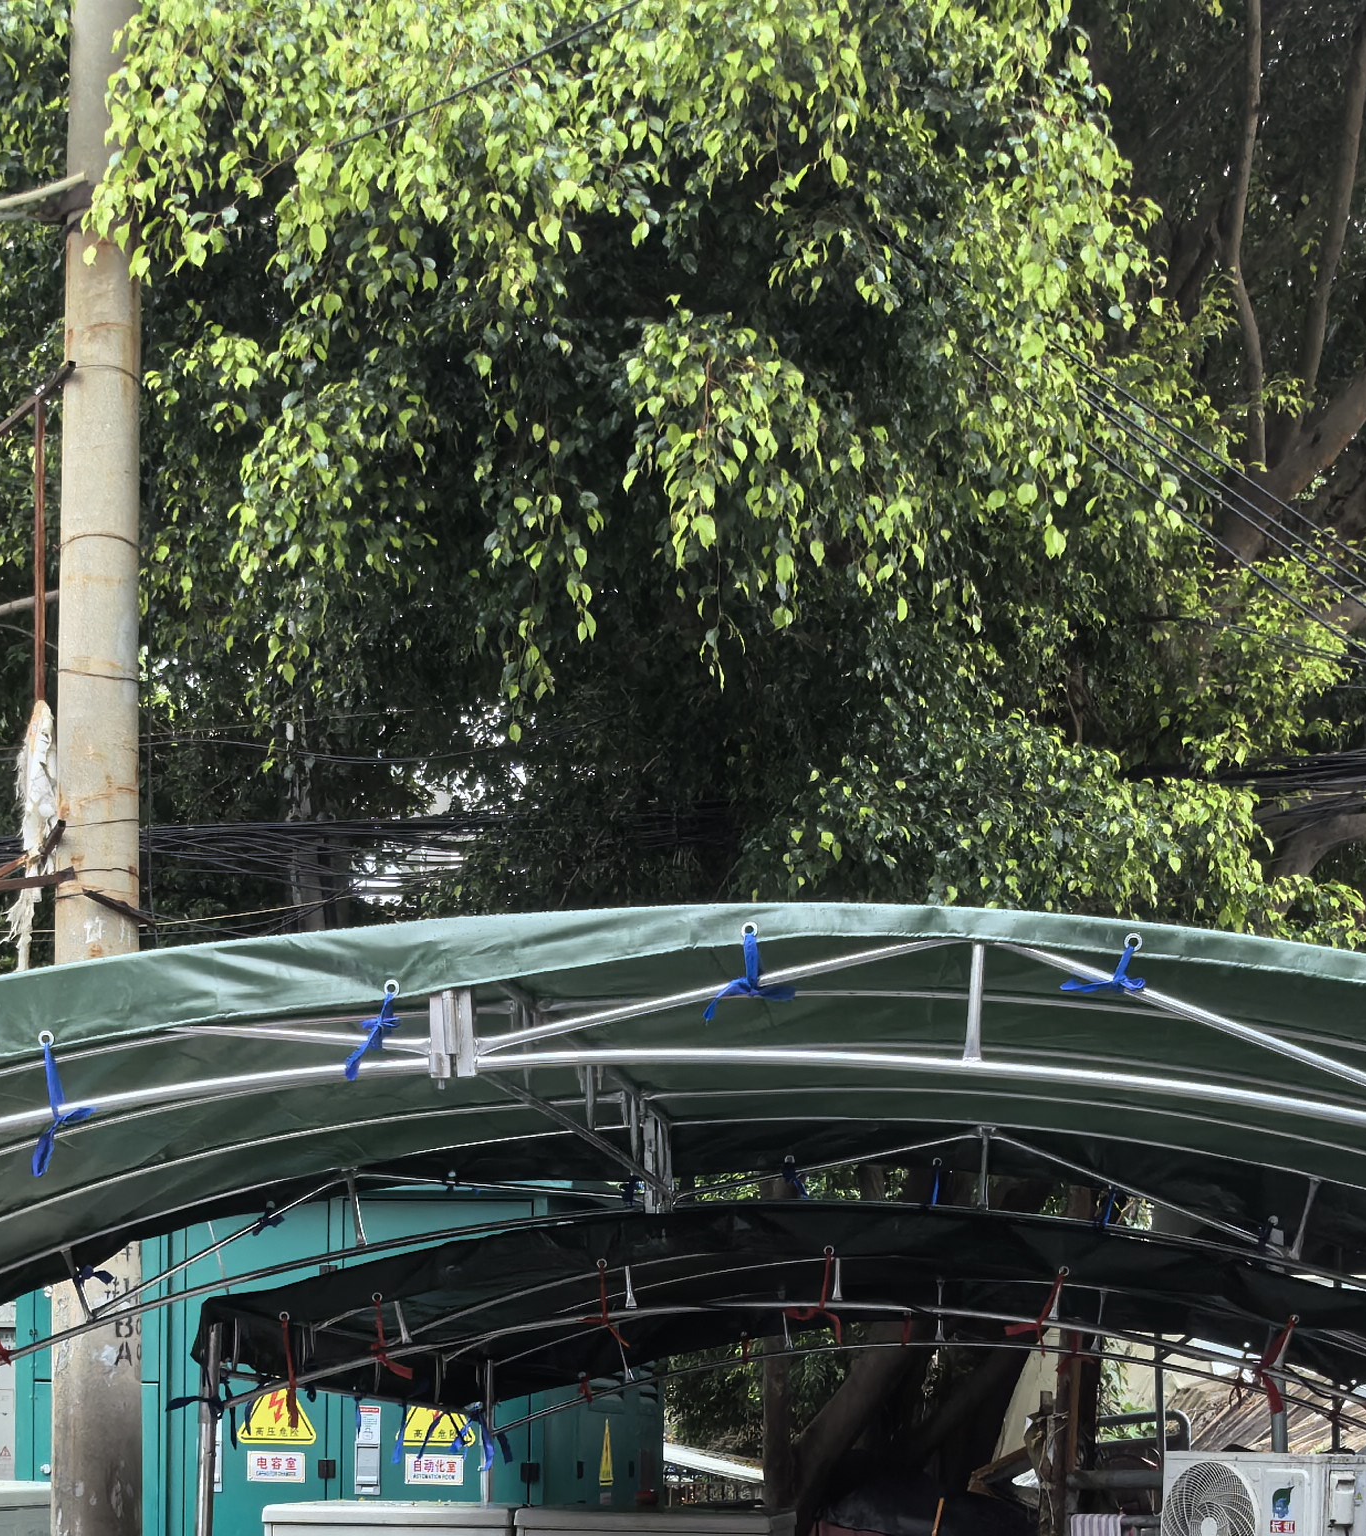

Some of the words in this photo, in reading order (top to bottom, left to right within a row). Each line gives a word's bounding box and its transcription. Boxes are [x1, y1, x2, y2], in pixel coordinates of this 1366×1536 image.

[256, 1456, 297, 1471] 电容室
[413, 1459, 457, 1473] 自动化室
